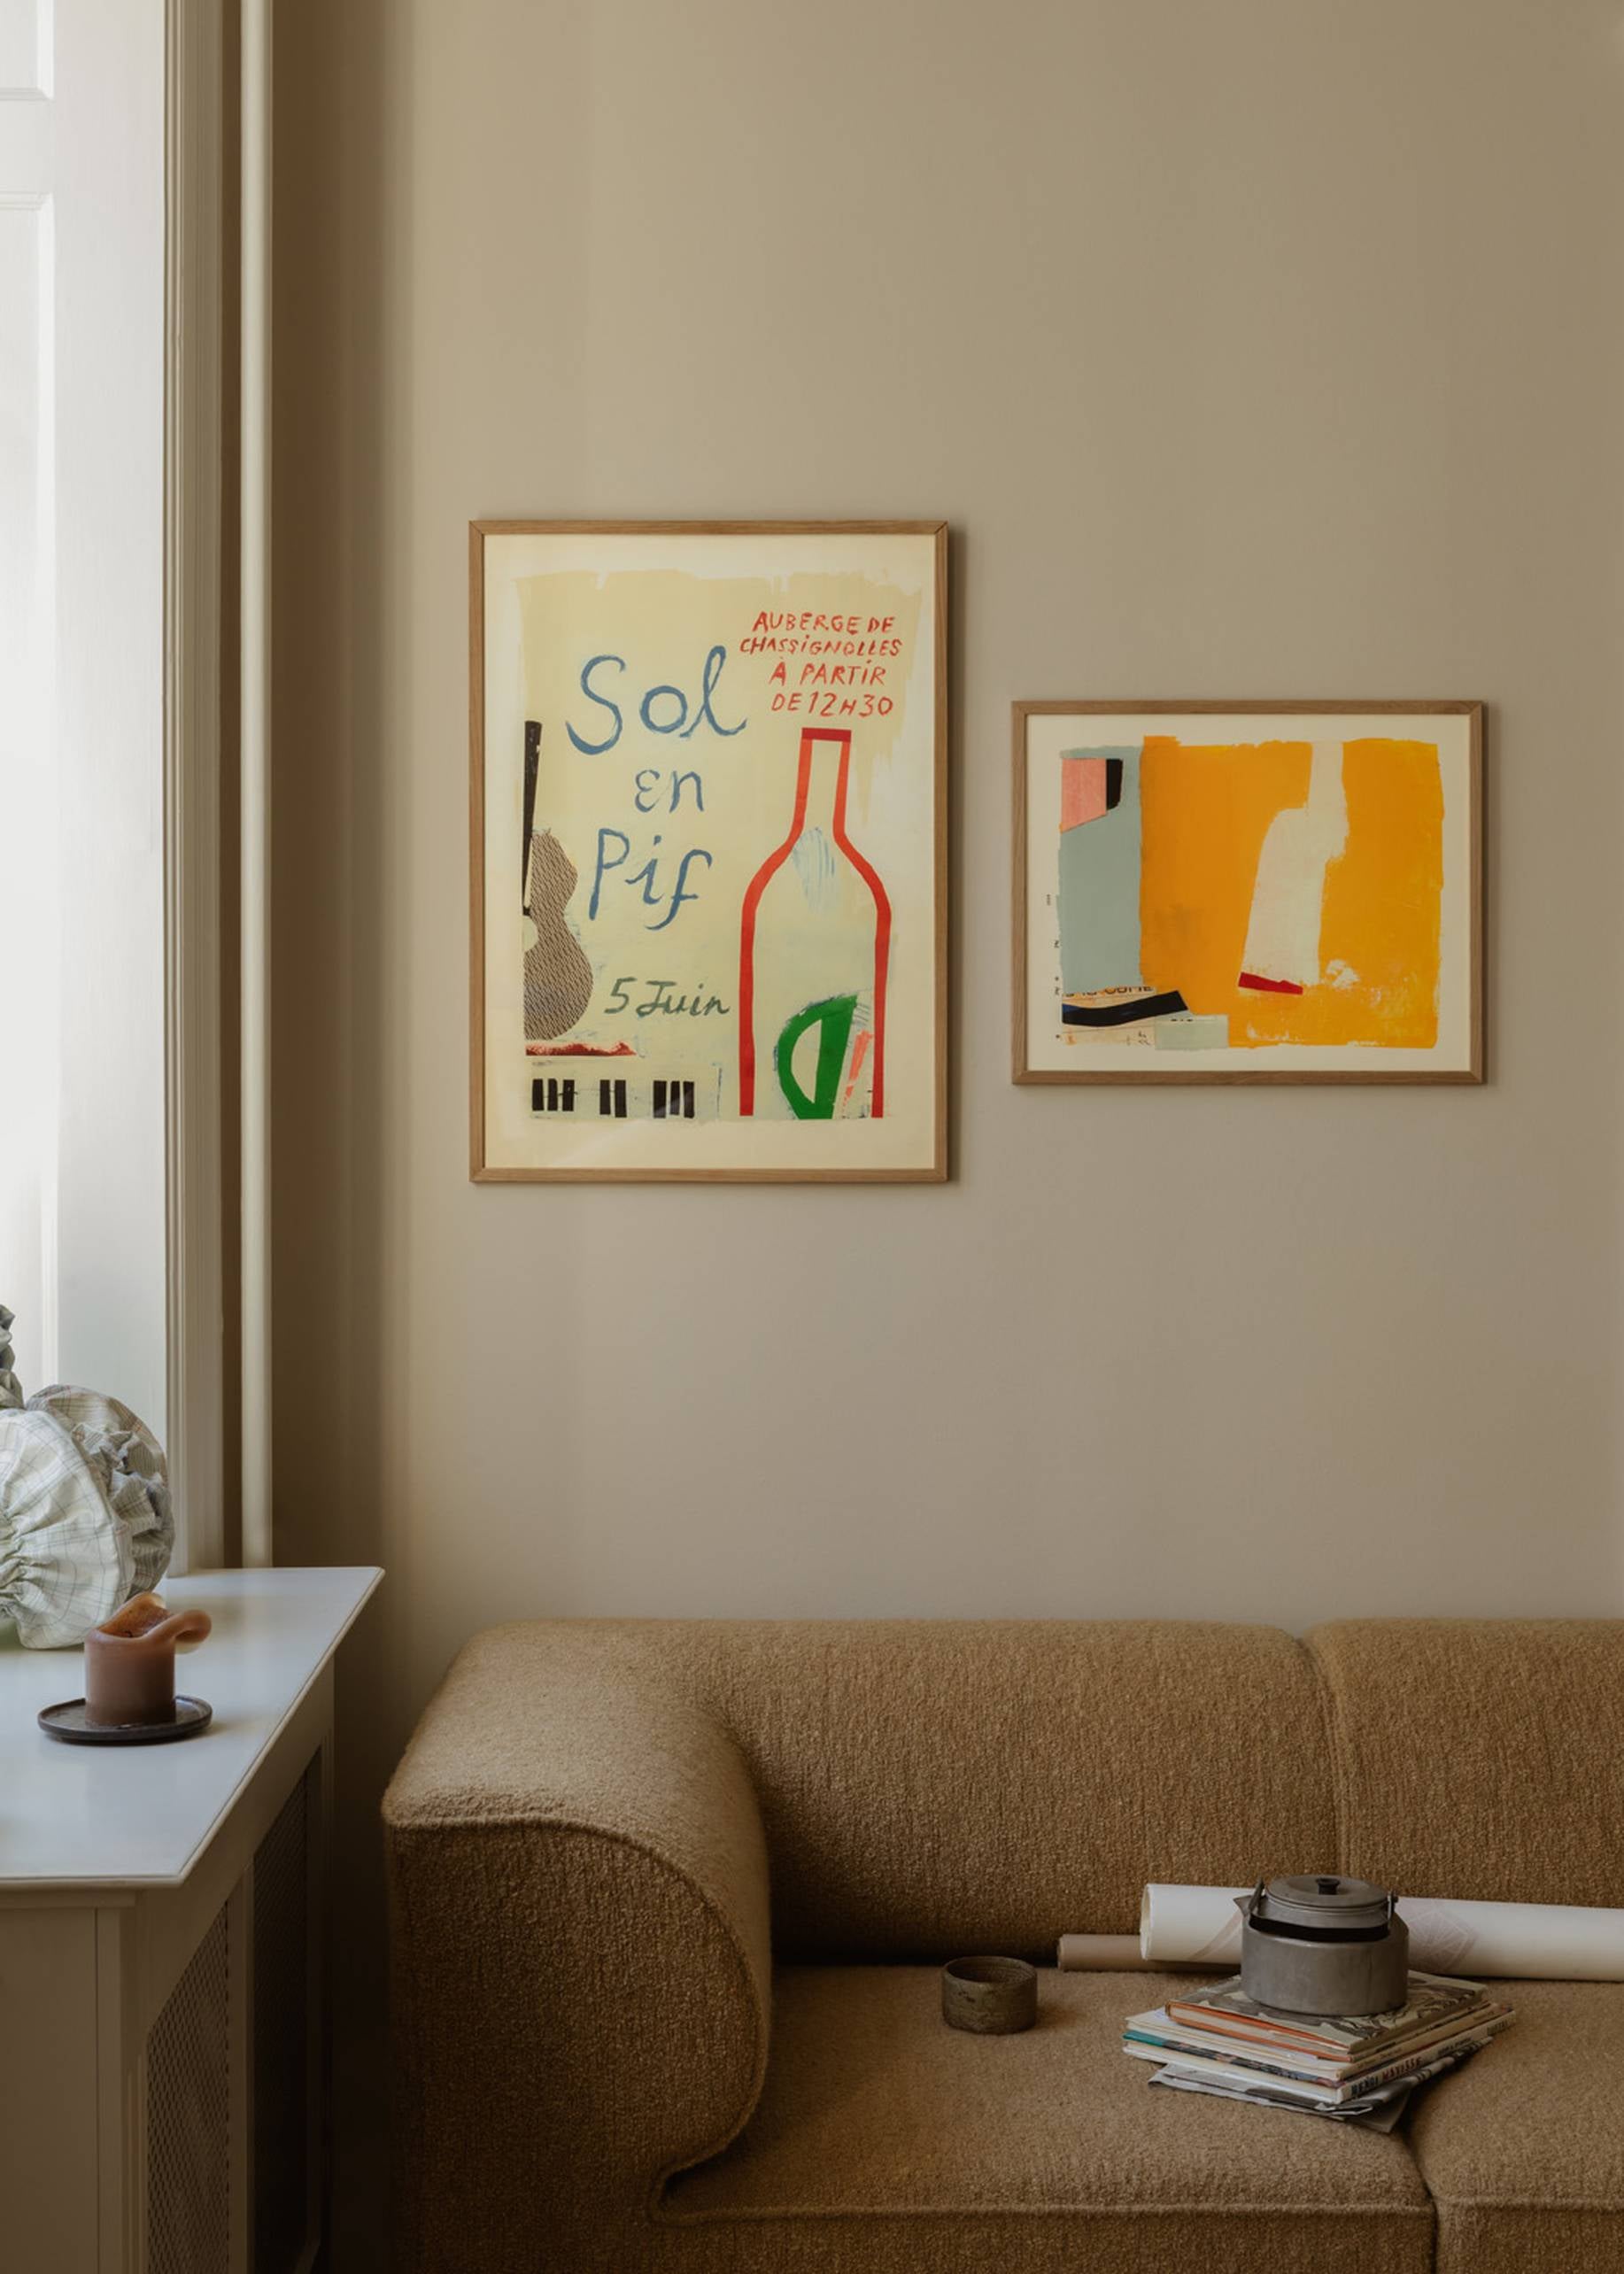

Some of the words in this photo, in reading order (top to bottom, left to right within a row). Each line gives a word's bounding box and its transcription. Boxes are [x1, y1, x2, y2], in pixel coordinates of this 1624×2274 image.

[752, 611, 862, 635] AUBERGE
[867, 615, 895, 633] DE
[769, 656, 786, 686] À
[800, 660, 886, 686] PARTIR
[565, 646, 747, 755] Sol
[634, 769, 705, 814] en
[588, 828, 713, 931] Pif
[604, 977, 638, 1014] 5
[636, 980, 731, 1017] Juin
